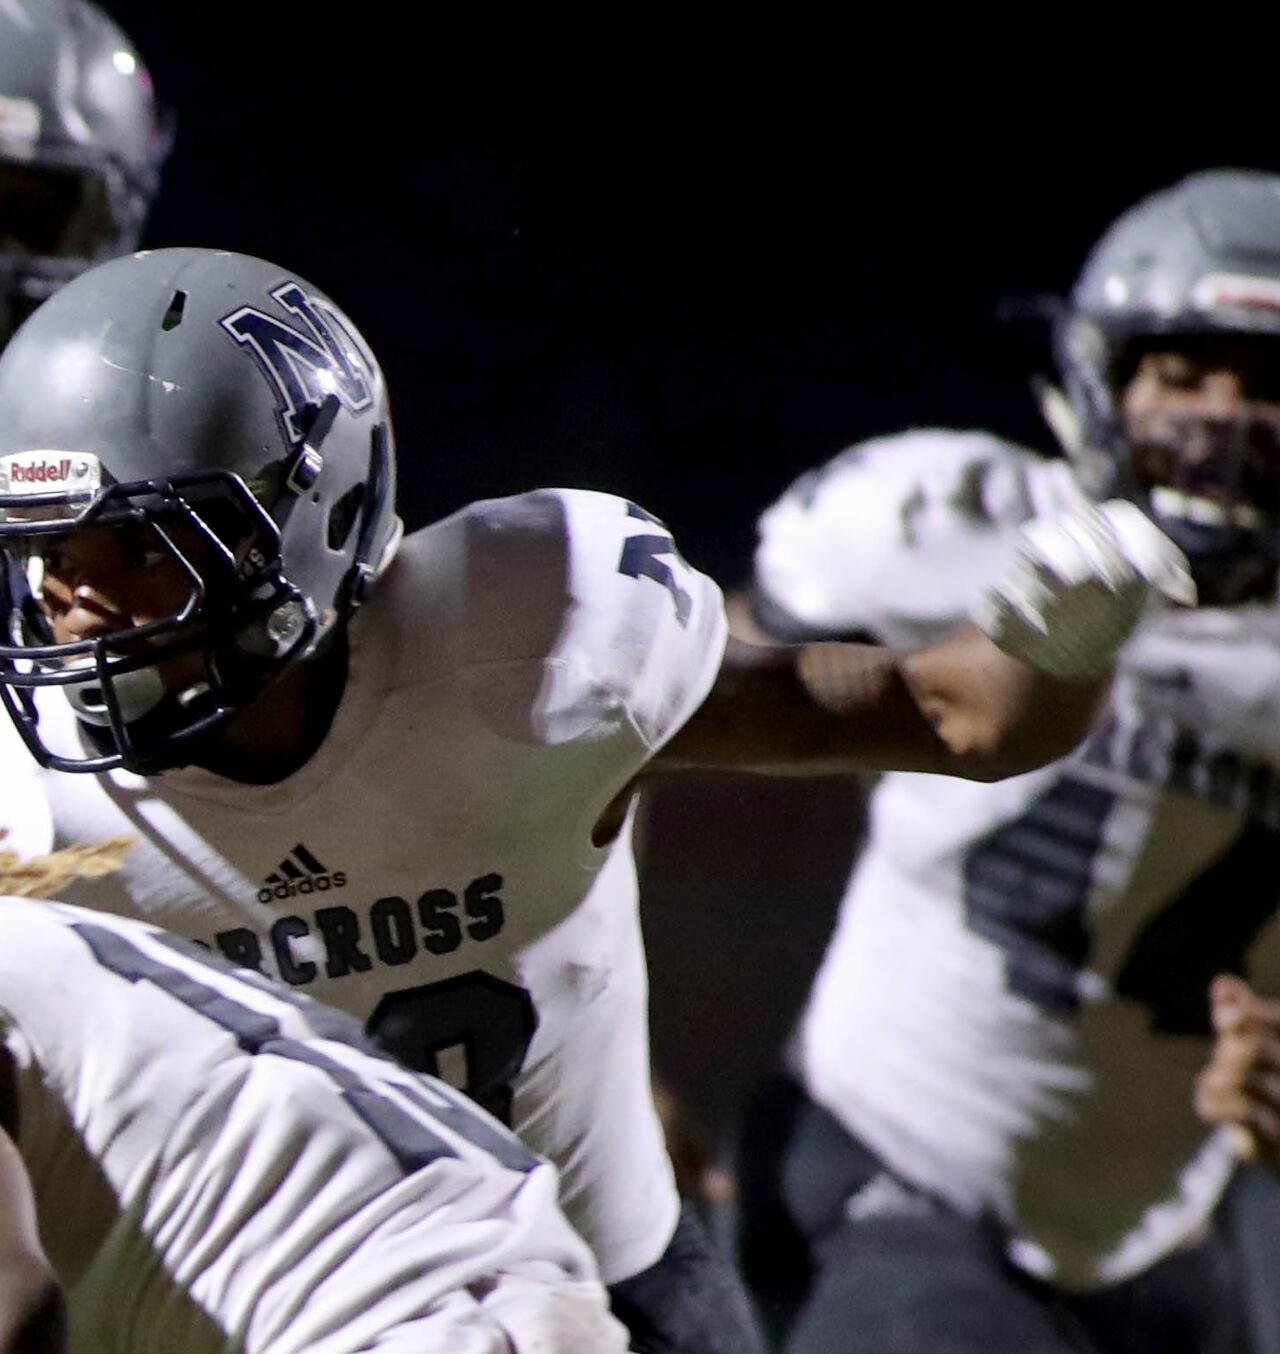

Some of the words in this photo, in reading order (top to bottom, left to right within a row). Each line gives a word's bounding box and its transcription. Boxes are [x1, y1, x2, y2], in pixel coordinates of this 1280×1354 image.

[217, 280, 373, 444] N
[10, 458, 72, 482] Riddell
[256, 869, 348, 904] adidas
[193, 871, 505, 986] RCROSS
